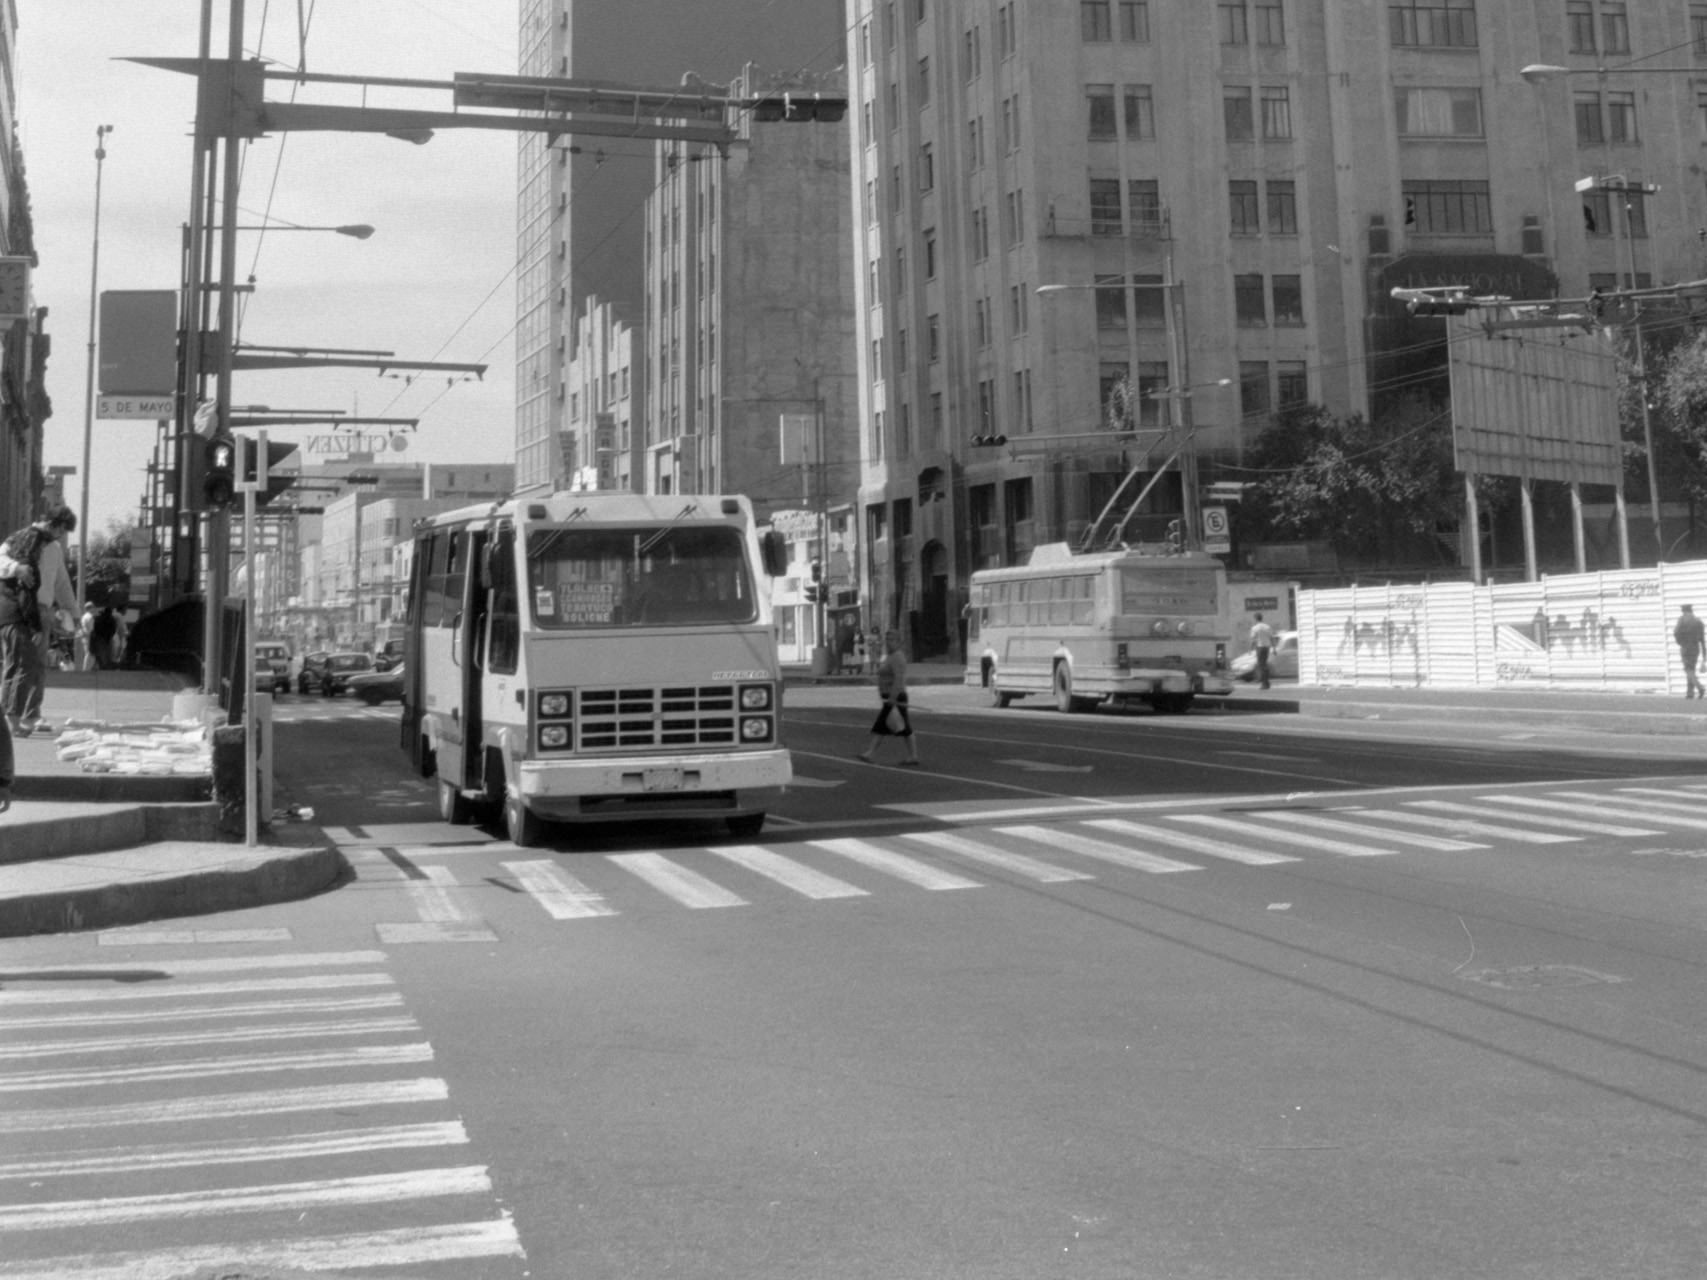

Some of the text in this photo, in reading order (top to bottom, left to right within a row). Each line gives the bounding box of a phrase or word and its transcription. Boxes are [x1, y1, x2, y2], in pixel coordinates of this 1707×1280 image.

[102, 402, 173, 413] 5 DE MAYO
